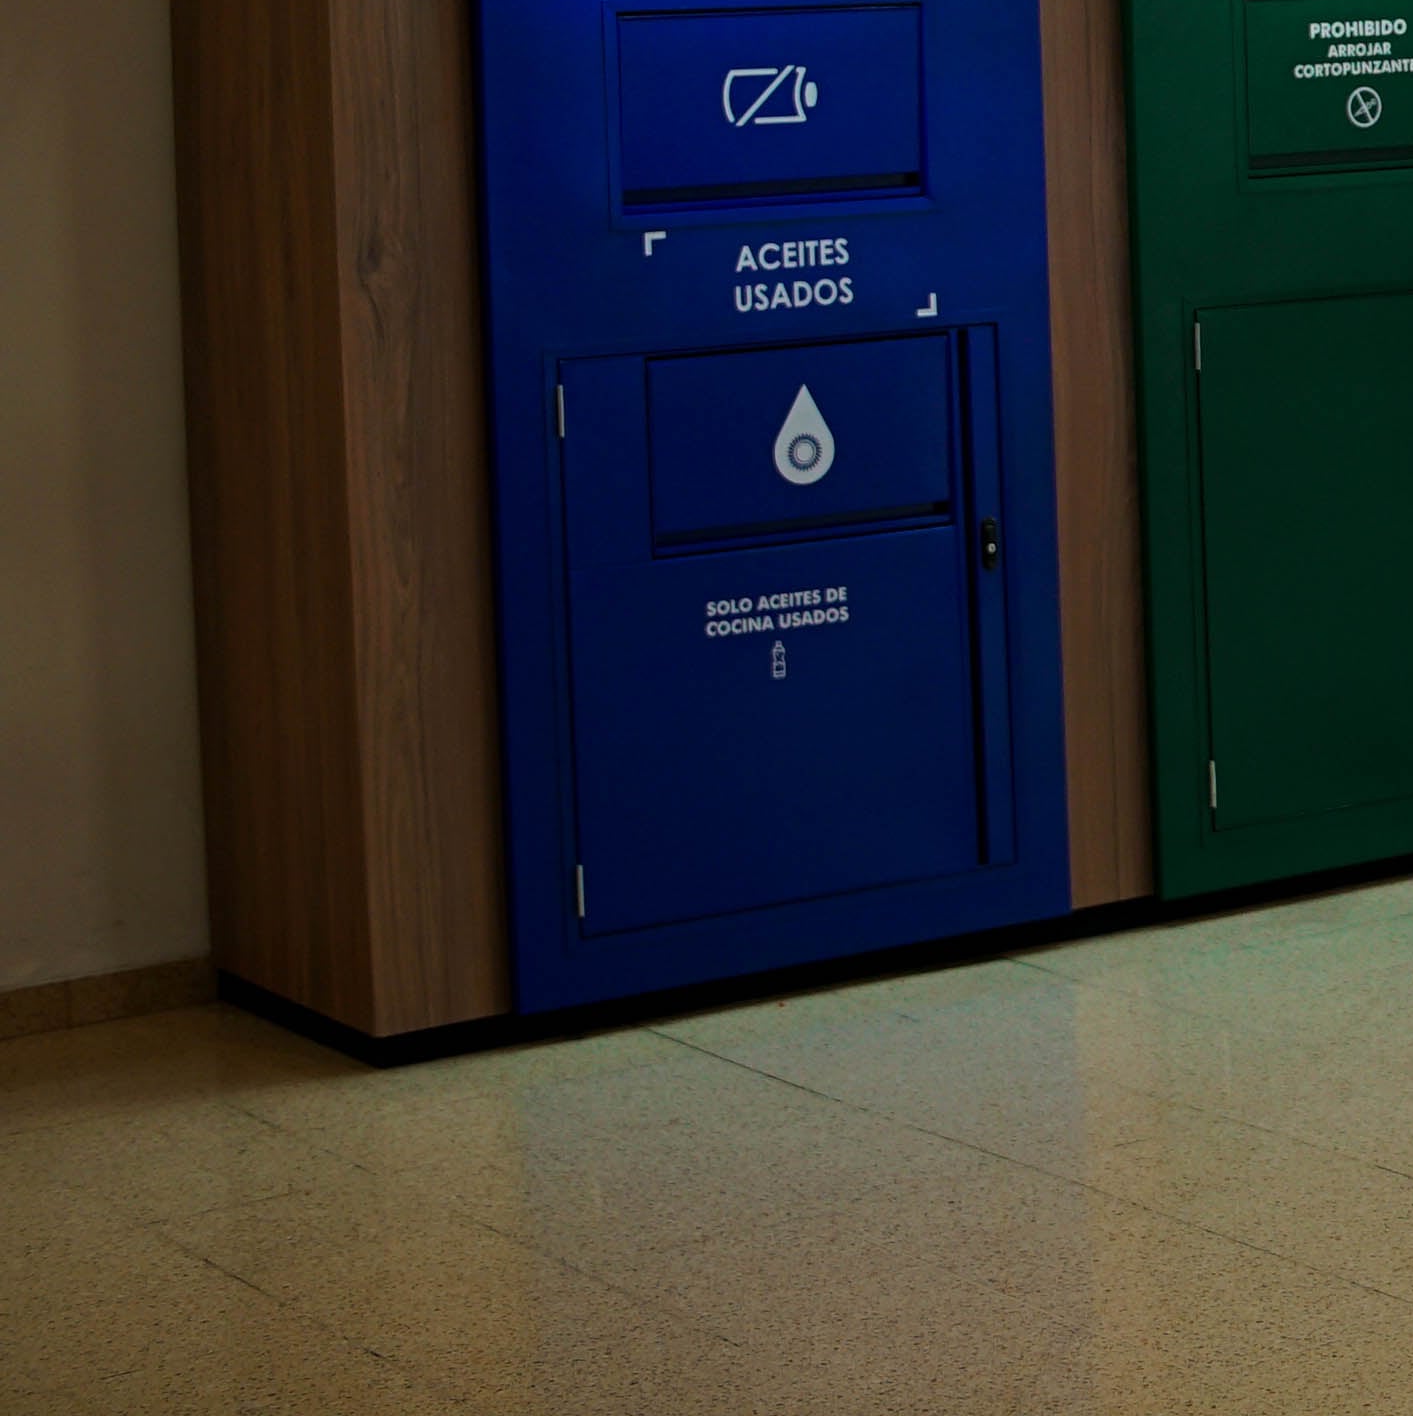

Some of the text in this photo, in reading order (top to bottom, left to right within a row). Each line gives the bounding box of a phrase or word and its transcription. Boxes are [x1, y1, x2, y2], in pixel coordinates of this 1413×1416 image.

[1309, 18, 1408, 40] PROHIBIDO
[1327, 41, 1392, 59] ARROJAR
[735, 237, 850, 273] ACEITES
[734, 277, 855, 313] USADOS
[705, 586, 848, 618] SOLO ACEITES DE
[705, 605, 850, 638] COCINA USADOS
